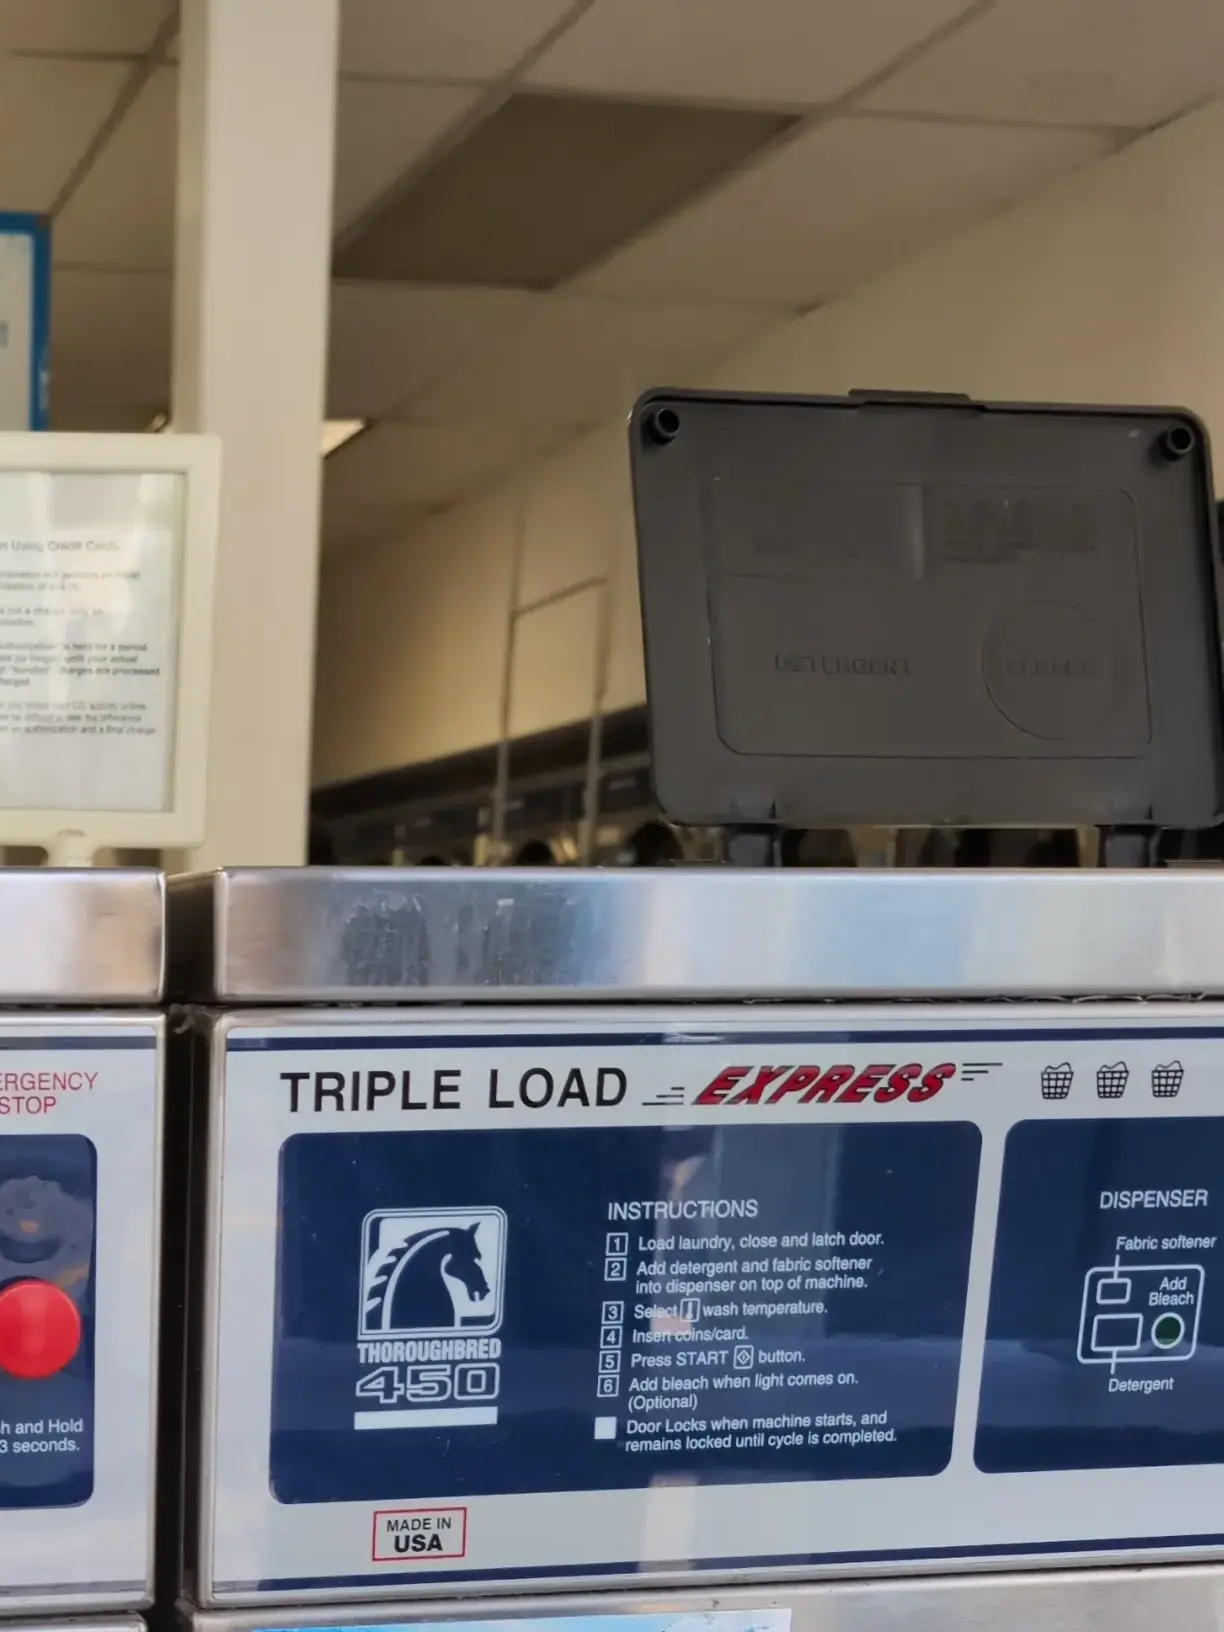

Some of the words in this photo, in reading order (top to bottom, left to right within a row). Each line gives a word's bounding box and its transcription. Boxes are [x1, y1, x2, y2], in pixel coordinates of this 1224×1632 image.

[280, 1069, 461, 1112] TRIPLE
[488, 1067, 627, 1110] LOAD
[691, 1063, 958, 1105] EXPRESS
[1100, 1189, 1208, 1209] DISPENSER
[608, 1200, 758, 1220] INSTRUCTIONS
[638, 1236, 674, 1251] Load
[679, 1235, 735, 1254] laundry,
[740, 1234, 777, 1248] close
[781, 1233, 807, 1247] and
[812, 1232, 845, 1246] latch
[849, 1231, 884, 1246] door.
[1116, 1236, 1158, 1251] Fabric
[1162, 1234, 1216, 1249] softener
[1159, 1276, 1187, 1291] Add
[1149, 1291, 1194, 1307] Bleach
[634, 1304, 677, 1318] Select
[703, 1303, 738, 1316] wash
[742, 1301, 827, 1318] temperature.
[633, 1328, 670, 1343] Insert
[675, 1326, 748, 1341] coins/card.
[357, 1338, 501, 1364] THOROUGHBRED
[631, 1353, 671, 1368] Press
[676, 1351, 728, 1366] START
[759, 1349, 805, 1363] button.
[356, 1362, 500, 1404] 450
[629, 1378, 658, 1391] Add
[662, 1376, 708, 1390] bleach
[713, 1375, 750, 1389] when
[755, 1373, 784, 1389] light
[787, 1373, 833, 1387] comes
[838, 1372, 858, 1385] on.
[1108, 1377, 1174, 1394] Detergent
[628, 1395, 697, 1412] (Optional)
[14, 1420, 43, 1435] and
[48, 1418, 83, 1433] Hold
[12, 1436, 80, 1452] seconds.
[386, 1518, 432, 1532] MADE
[436, 1517, 451, 1530] IN
[394, 1534, 443, 1553] USA
